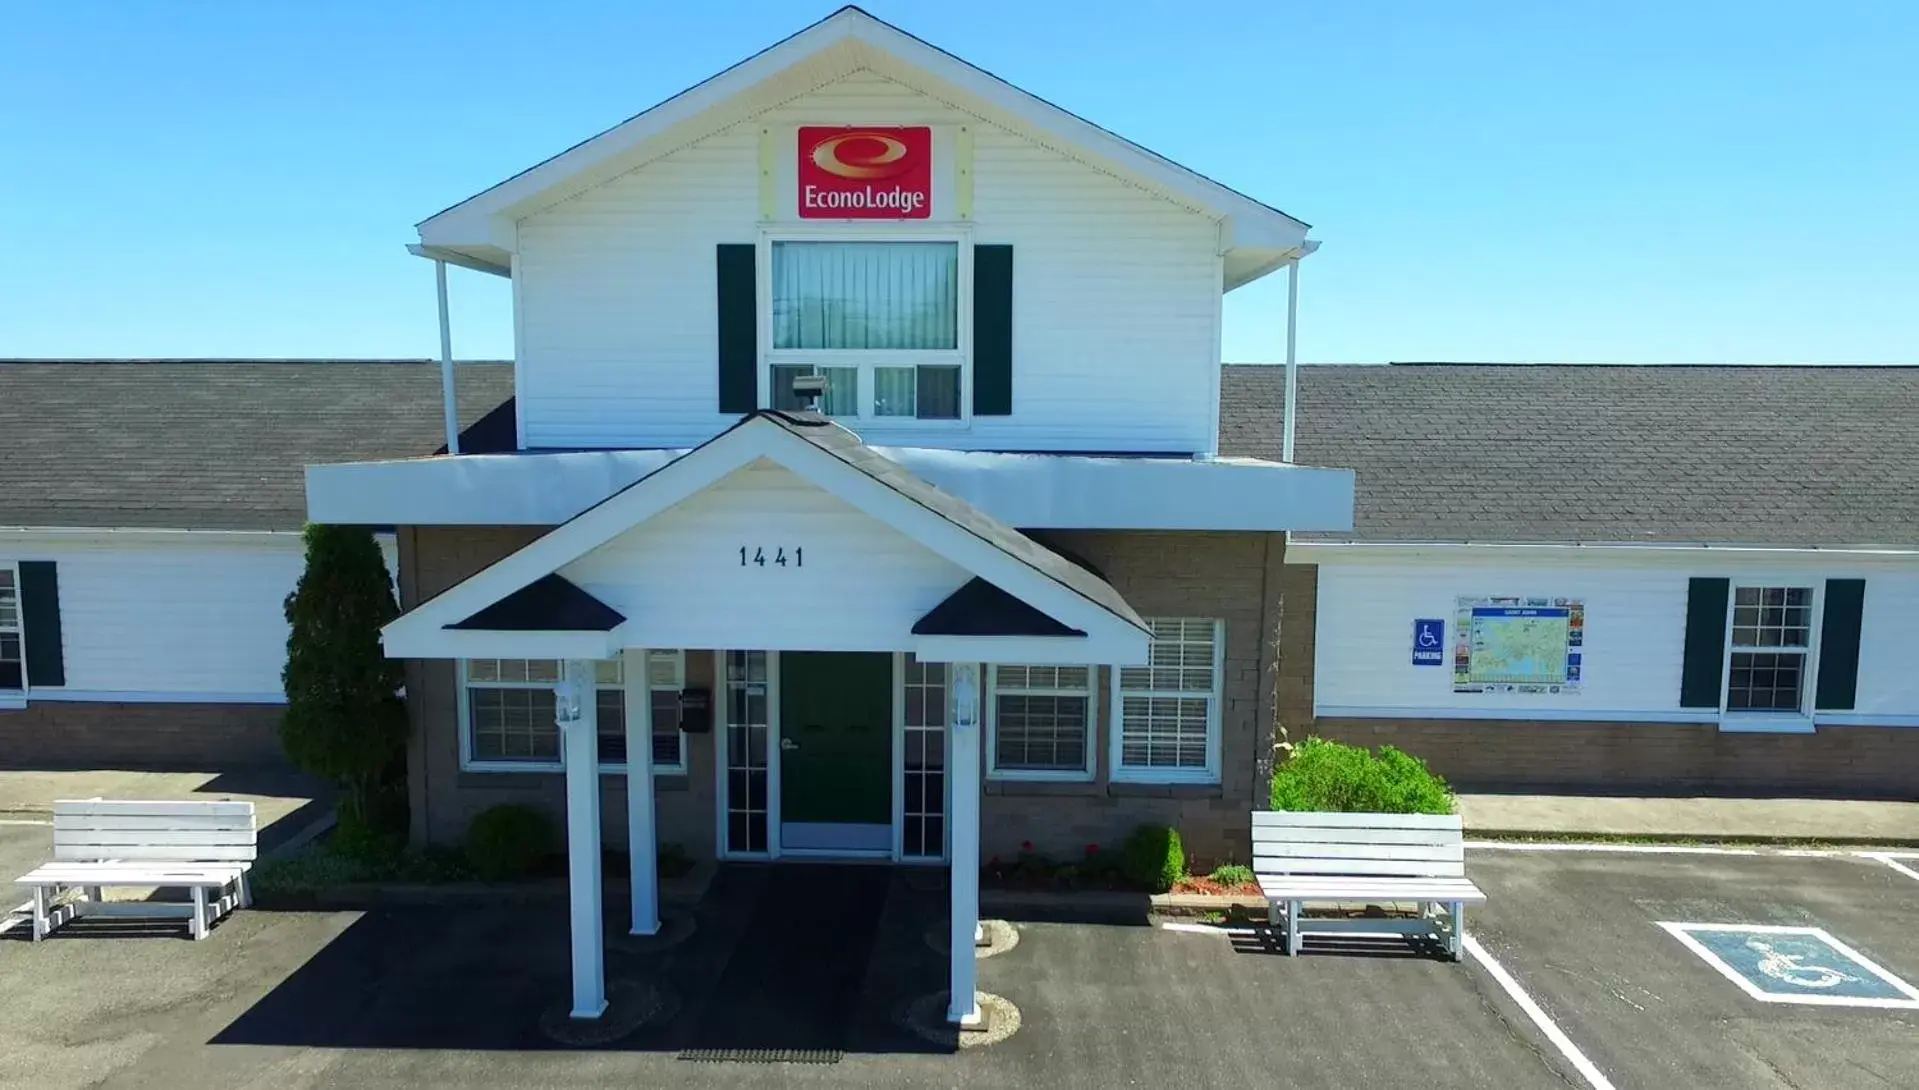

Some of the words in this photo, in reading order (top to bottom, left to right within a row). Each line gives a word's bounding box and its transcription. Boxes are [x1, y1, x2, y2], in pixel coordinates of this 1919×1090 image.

[804, 184, 925, 213] EconoLodge
[739, 545, 803, 567] 1441
[1414, 651, 1441, 660] PARKING
